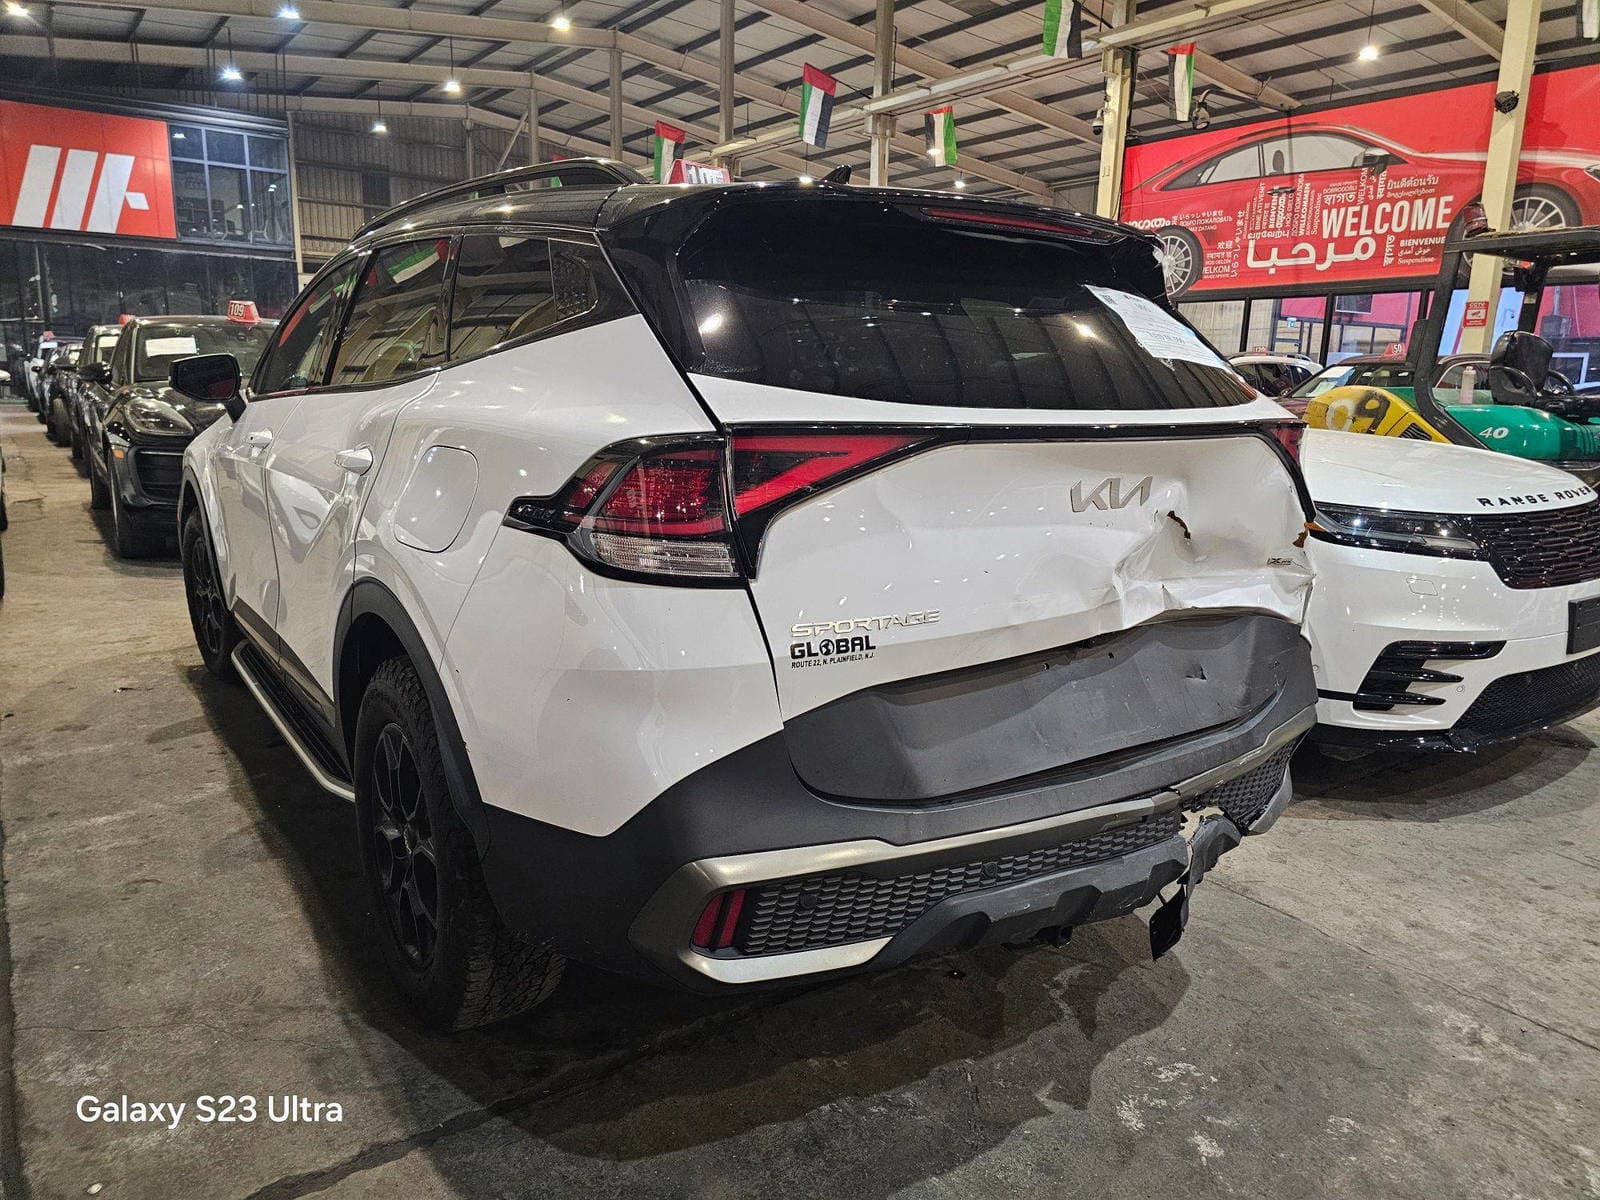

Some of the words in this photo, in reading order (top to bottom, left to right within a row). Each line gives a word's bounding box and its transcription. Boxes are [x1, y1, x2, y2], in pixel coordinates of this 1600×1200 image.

[1298, 182, 1311, 236] WILLKOMMEN
[1322, 195, 1454, 239] WELCOME
[1399, 236, 1446, 247] BIENVENUE
[1247, 236, 1377, 274] مرحبا
[230, 303, 244, 316] 109
[1479, 426, 1509, 439] 40
[1070, 475, 1154, 512] KIA
[1476, 493, 1550, 507] RANGE
[1553, 485, 1592, 501] ROVER
[790, 608, 942, 638] SPORTAGE
[789, 635, 877, 660] GLOBAL
[791, 659, 813, 669] ROUTE
[813, 658, 822, 668] 22,
[829, 652, 864, 665] PLAINFIELD,
[864, 652, 875, 660] N.J.
